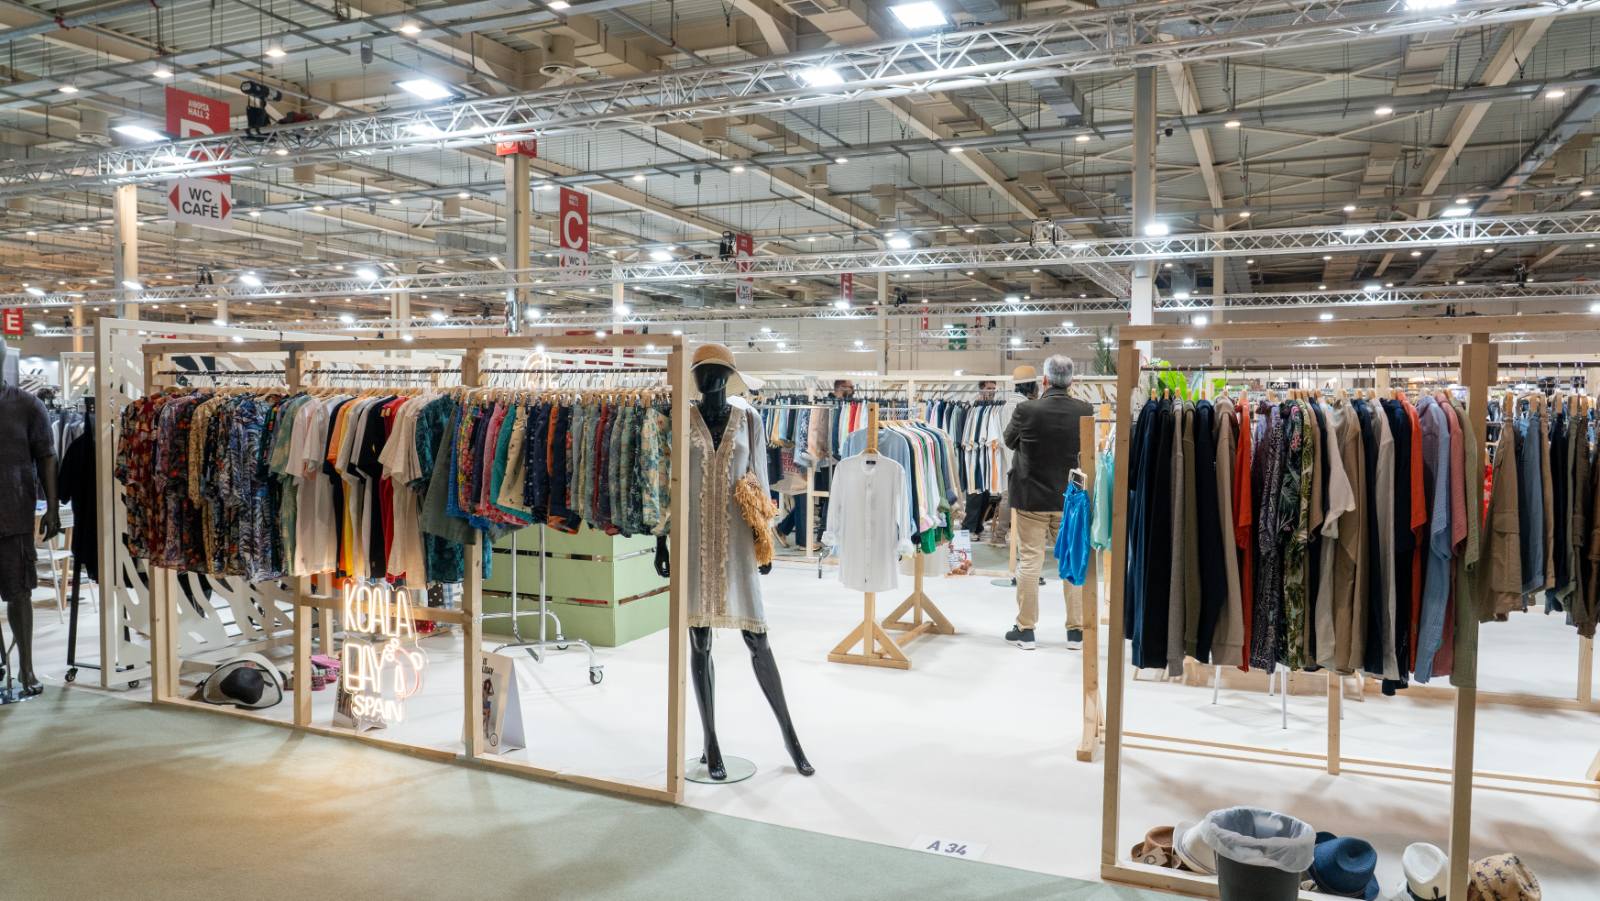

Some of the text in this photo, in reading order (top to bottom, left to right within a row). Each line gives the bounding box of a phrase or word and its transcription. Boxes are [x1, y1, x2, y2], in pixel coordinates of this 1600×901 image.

[204, 112, 210, 121] 2
[188, 187, 213, 203] WC
[182, 201, 220, 218] CAFÉ
[564, 210, 584, 250] C
[568, 256, 580, 266] WC
[7, 313, 20, 330] E
[345, 583, 412, 638] KOALA
[345, 643, 387, 693] DAY
[353, 694, 403, 722] SPAIN
[926, 840, 968, 856] A 34
